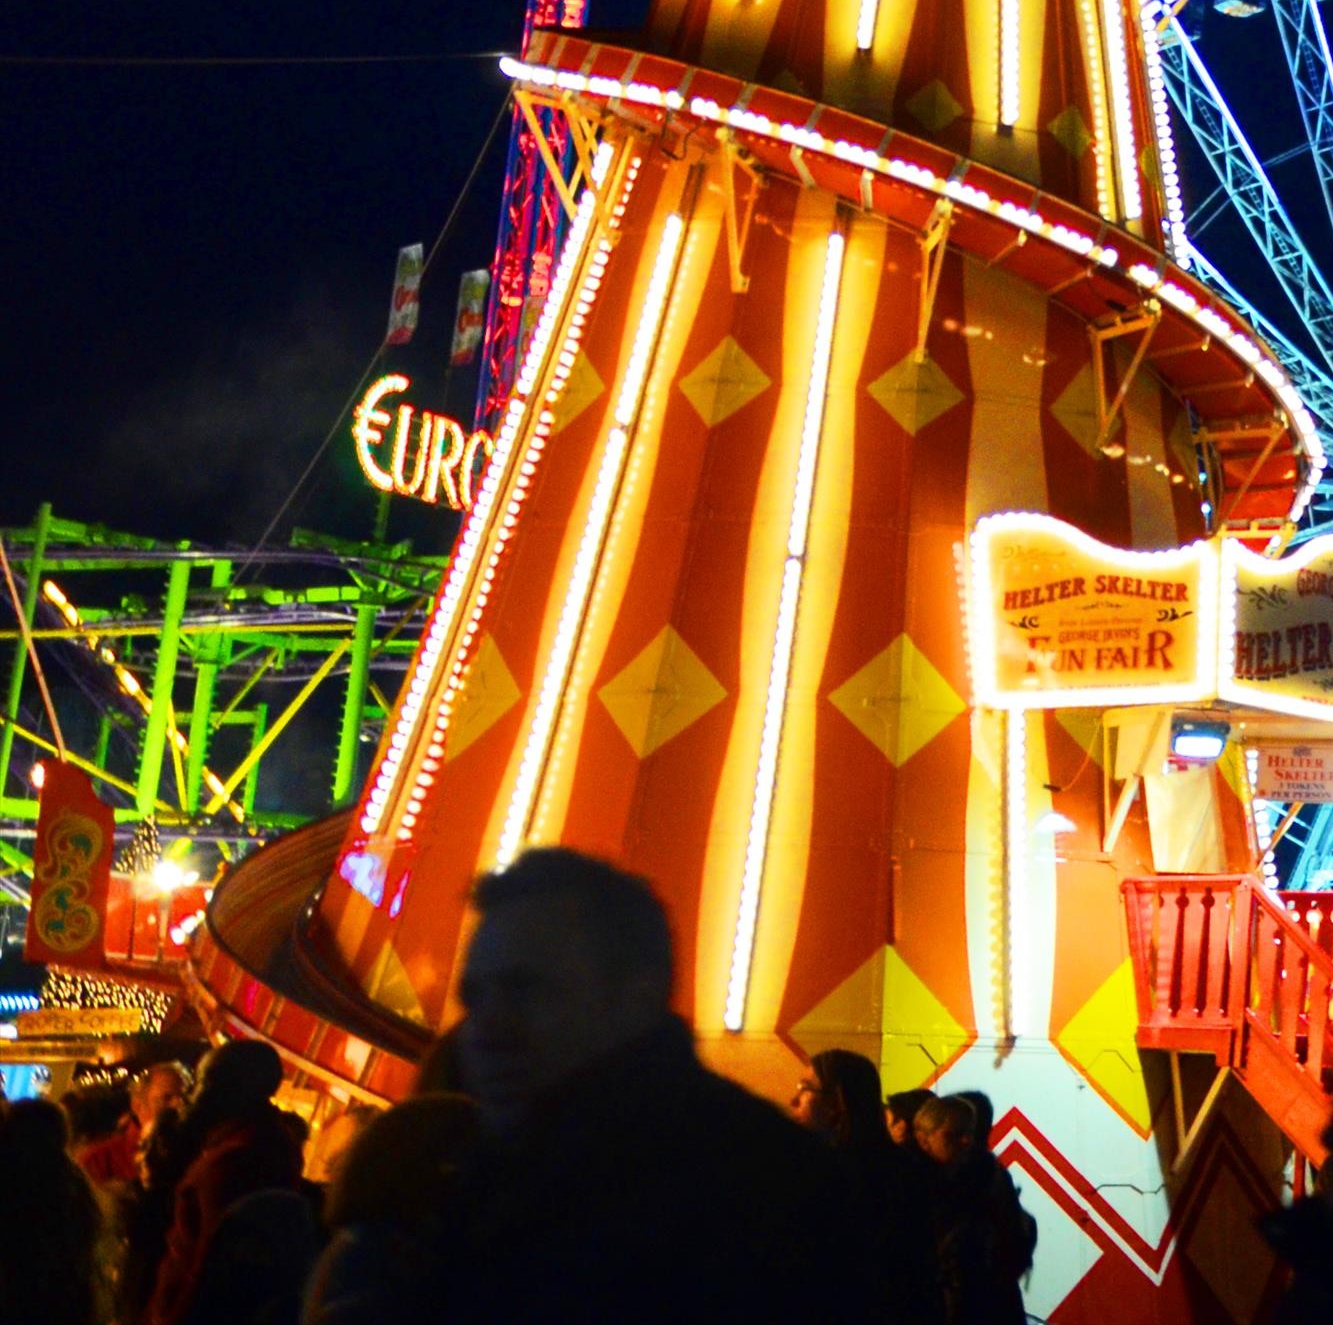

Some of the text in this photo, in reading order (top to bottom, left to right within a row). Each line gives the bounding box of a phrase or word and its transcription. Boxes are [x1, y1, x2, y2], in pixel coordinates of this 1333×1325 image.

[1003, 575, 1189, 611] HELTER SKELTER
[1058, 629, 1099, 644] GEORGE
[1095, 630, 1174, 671] FAIR
[1235, 622, 1333, 681] HELTER
[1268, 755, 1324, 768] HELTER
